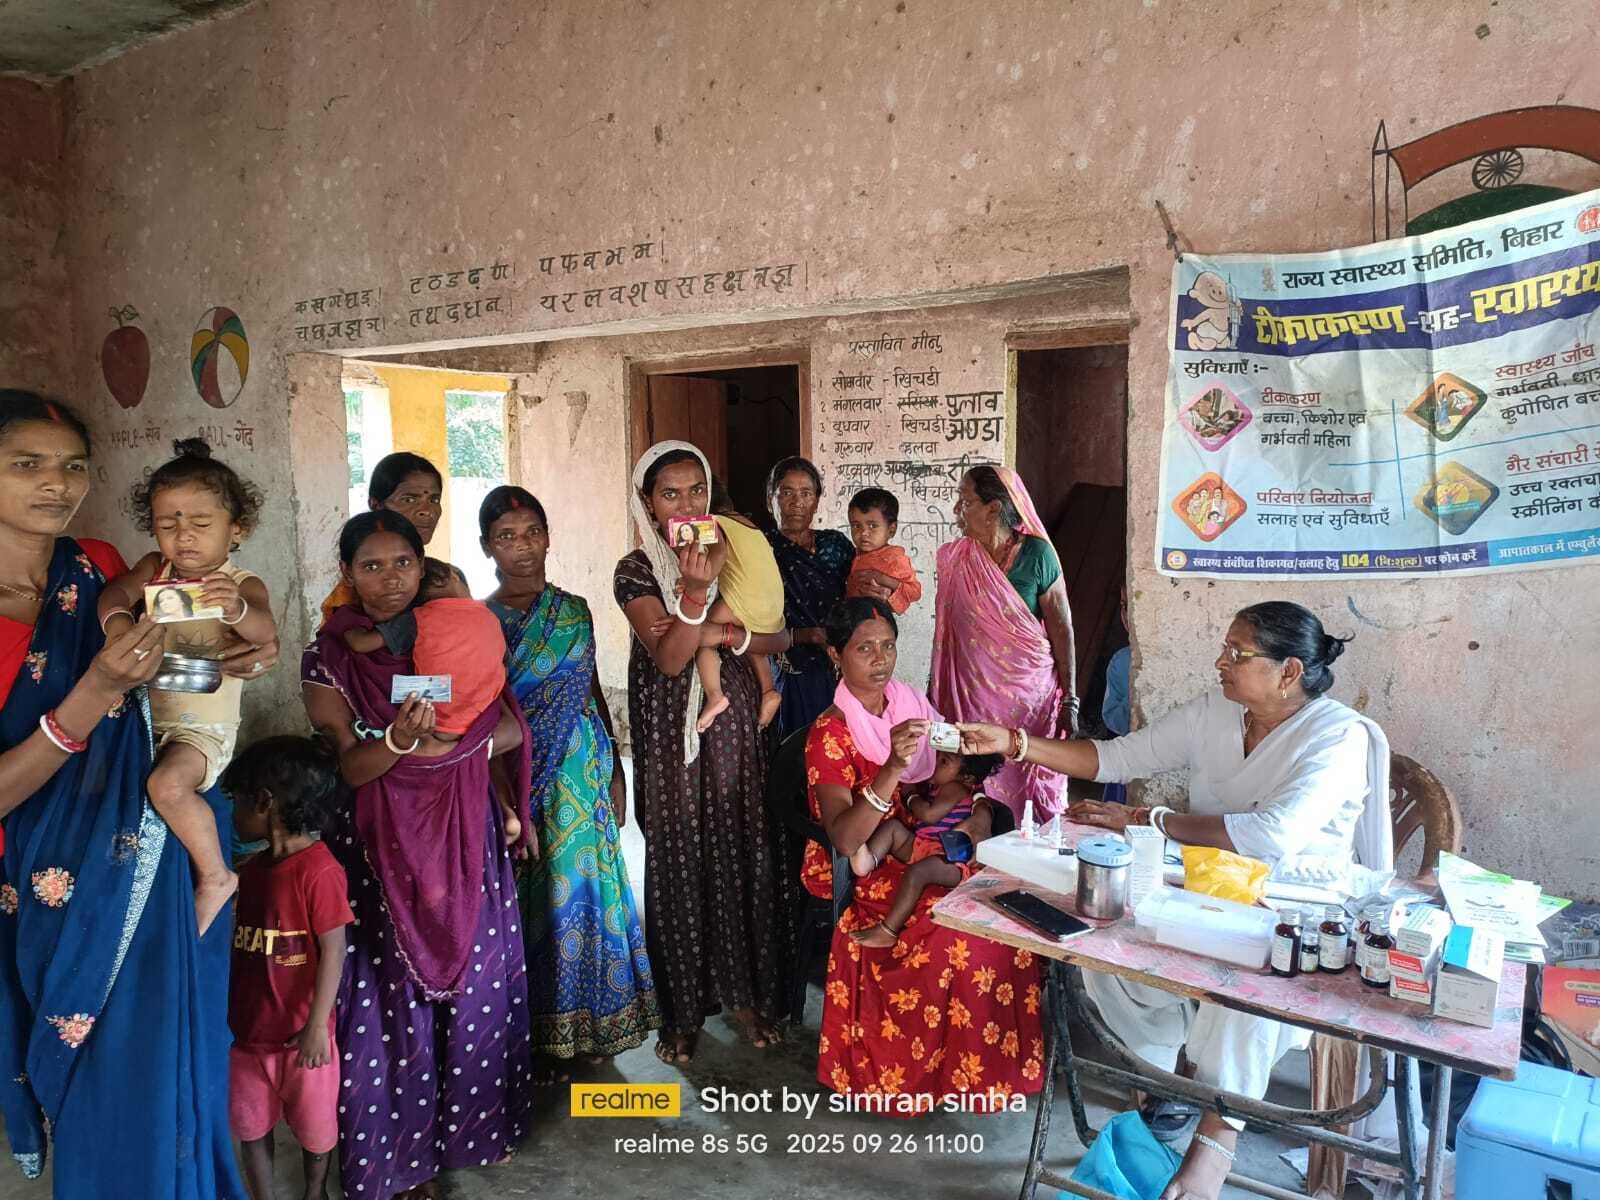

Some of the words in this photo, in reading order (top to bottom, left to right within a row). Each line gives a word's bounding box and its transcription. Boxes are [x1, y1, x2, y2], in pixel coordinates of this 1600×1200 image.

[1282, 271, 1325, 289] राज्य
[1329, 259, 1406, 285] स्वास्थ्य
[1500, 220, 1565, 252] बिहार
[1495, 354, 1556, 377] स्वास्थ्य
[832, 395, 883, 413] मंगलवार
[945, 391, 1004, 417] पुलाव
[1261, 387, 1321, 405] टीकाकरण
[1301, 411, 1345, 425] किशोर
[1348, 409, 1368, 428] एवं
[1500, 395, 1569, 424] कुपोषित
[1261, 428, 1310, 446] गर्भवती
[1313, 429, 1351, 447] महिला
[1505, 454, 1530, 471] गैर
[1536, 443, 1588, 468] संचारी
[1256, 488, 1304, 504] परिवार
[1310, 488, 1373, 504] नियोजन
[1509, 481, 1543, 496] उच्च
[1257, 511, 1297, 528] सलाह
[1302, 510, 1325, 528] एवं
[1329, 506, 1390, 530] सुविधाएँ
[1512, 496, 1583, 519] स्क्रीनिंग
[1342, 553, 1369, 567] 104
